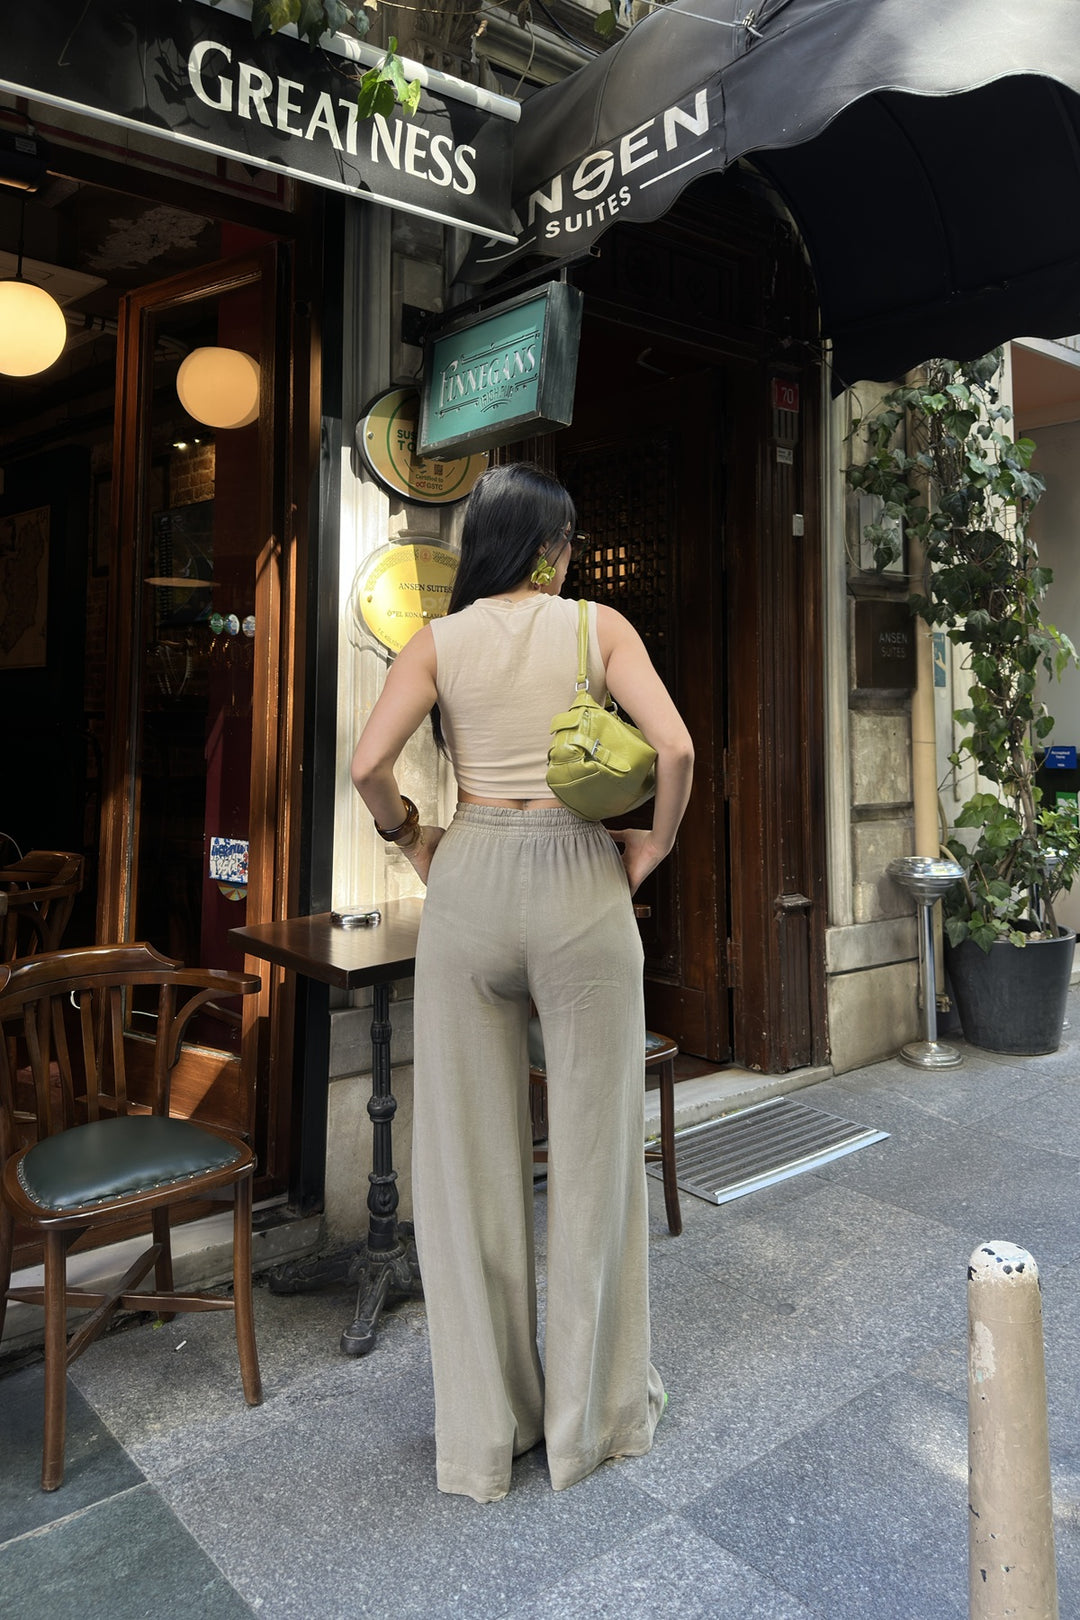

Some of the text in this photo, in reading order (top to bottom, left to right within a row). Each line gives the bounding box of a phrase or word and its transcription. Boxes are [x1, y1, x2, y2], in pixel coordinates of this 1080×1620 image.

[188, 40, 477, 195] GREATNESS
[545, 185, 632, 239] SUITES
[439, 344, 537, 408] FINNEGANS
[780, 386, 794, 405] 70
[399, 583, 453, 593] ANSEN SUITES
[879, 632, 908, 644] ANSEN
[880, 646, 906, 658] SUITES
